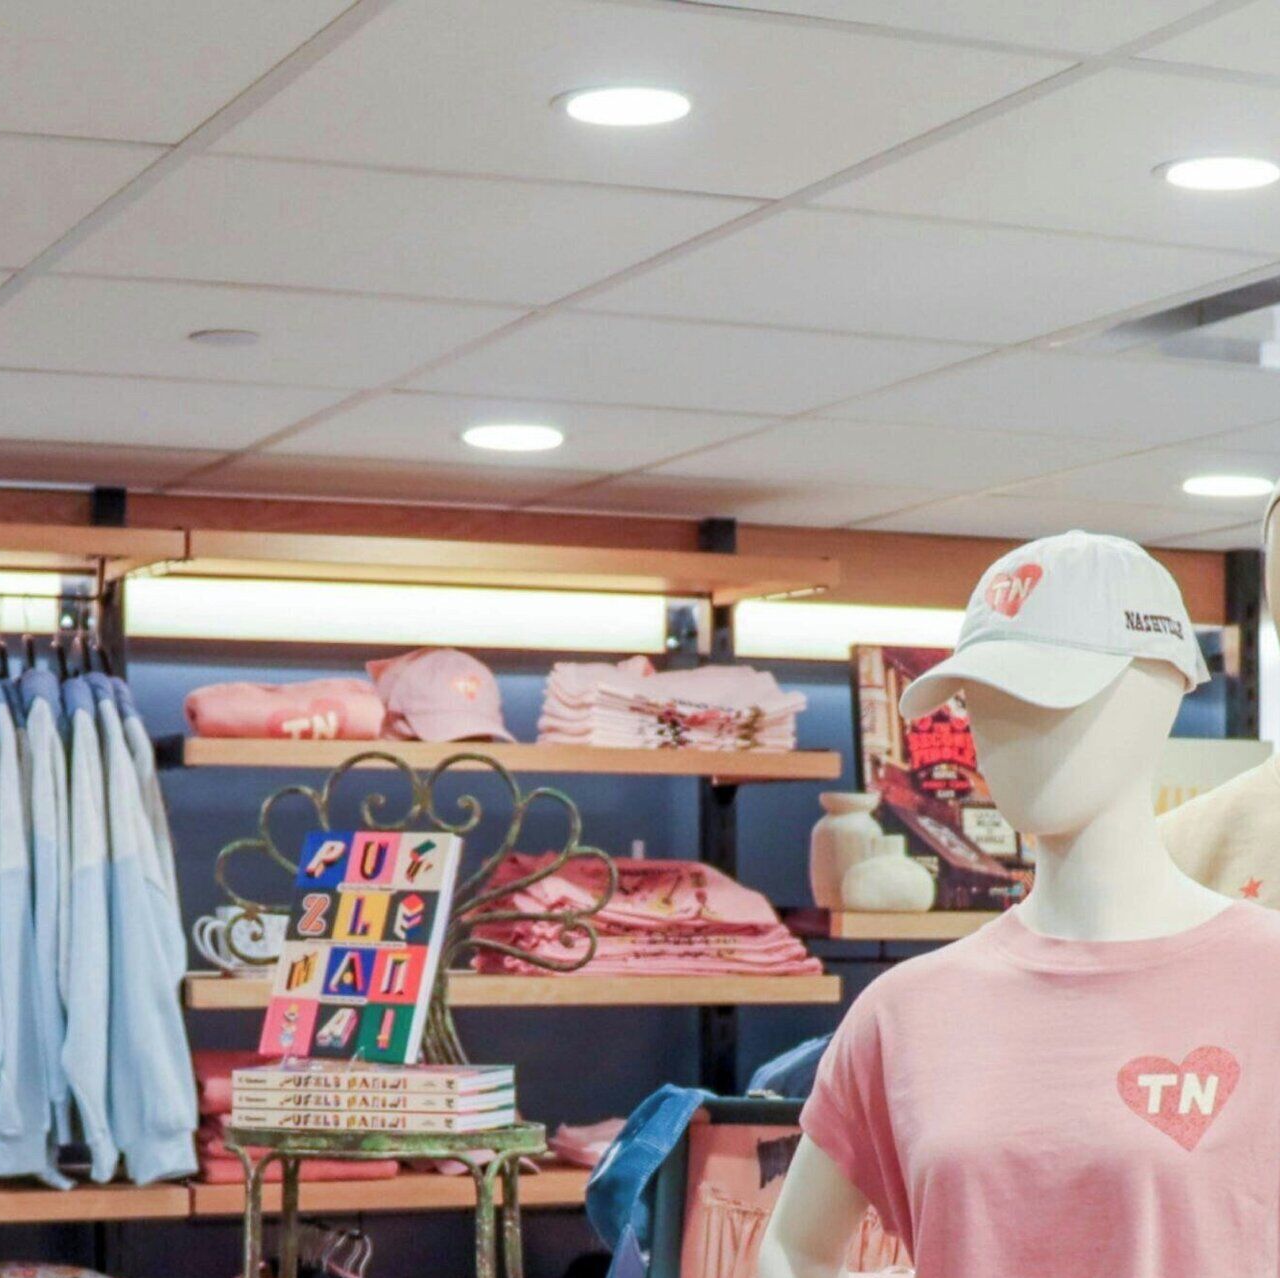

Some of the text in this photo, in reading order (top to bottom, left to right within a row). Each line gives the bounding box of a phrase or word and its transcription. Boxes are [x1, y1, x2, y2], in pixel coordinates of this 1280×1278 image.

[992, 576, 1034, 607] TN
[282, 710, 337, 740] TN
[1137, 1072, 1219, 1115] TN
